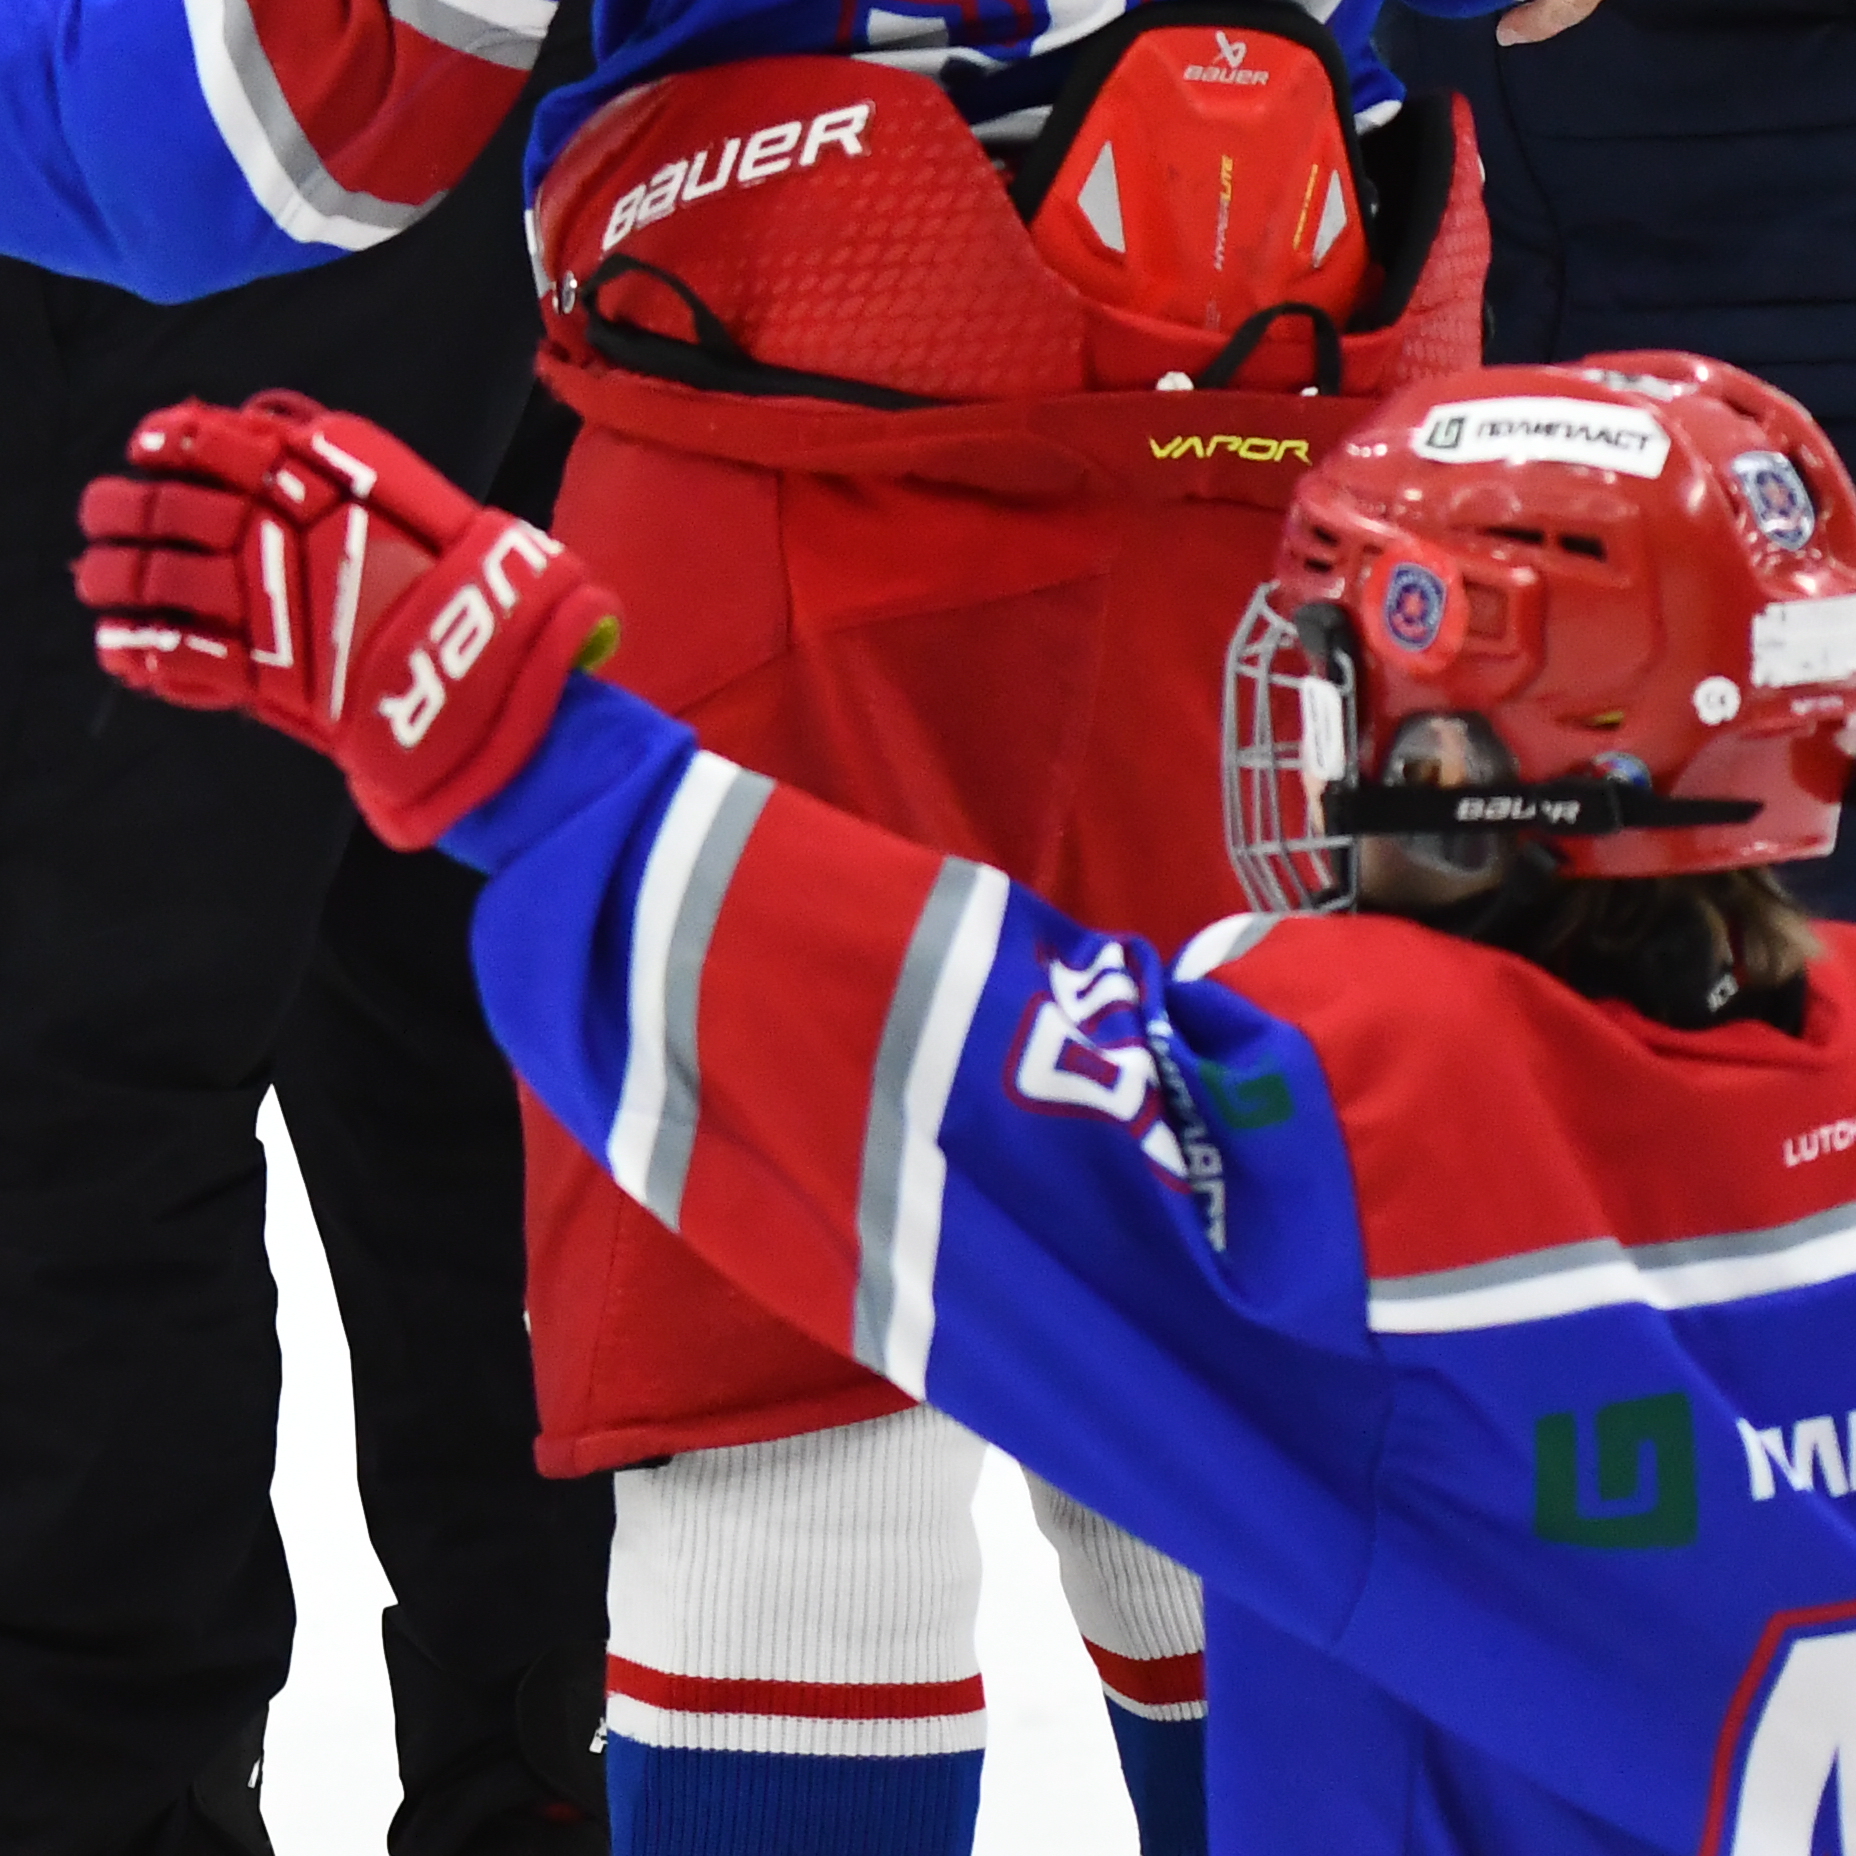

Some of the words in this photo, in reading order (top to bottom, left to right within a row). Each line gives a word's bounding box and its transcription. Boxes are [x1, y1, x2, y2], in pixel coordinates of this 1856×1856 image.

[1183, 64, 1270, 86] BAUER
[601, 100, 876, 251] BAUER
[1149, 434, 1313, 466] VAPOR
